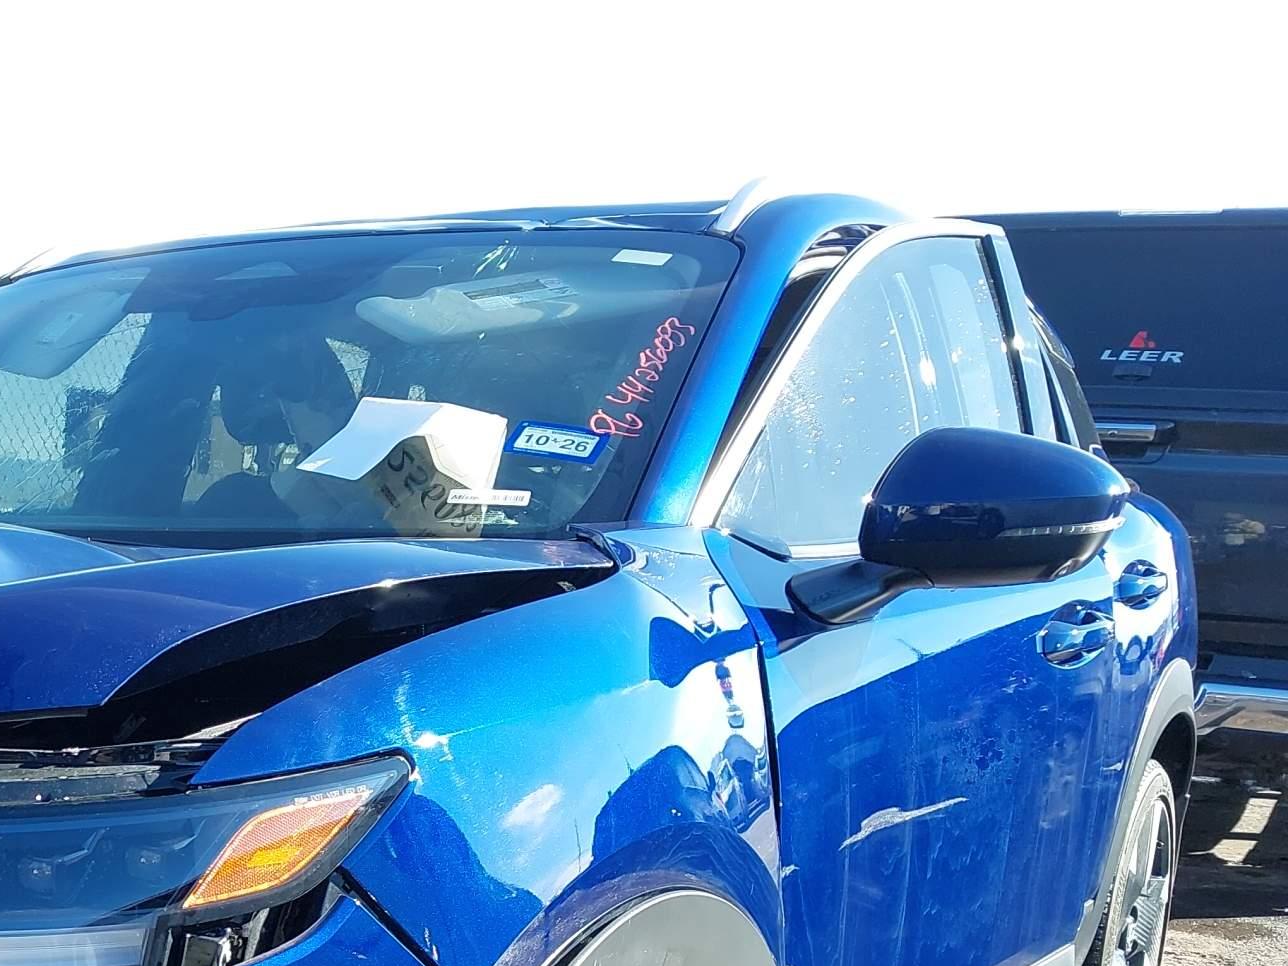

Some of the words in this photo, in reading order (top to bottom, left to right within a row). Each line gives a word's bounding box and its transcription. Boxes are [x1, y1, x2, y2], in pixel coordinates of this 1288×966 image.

[1100, 350, 1185, 363] LEER
[523, 433, 551, 447] 10
[558, 438, 590, 453] 26
